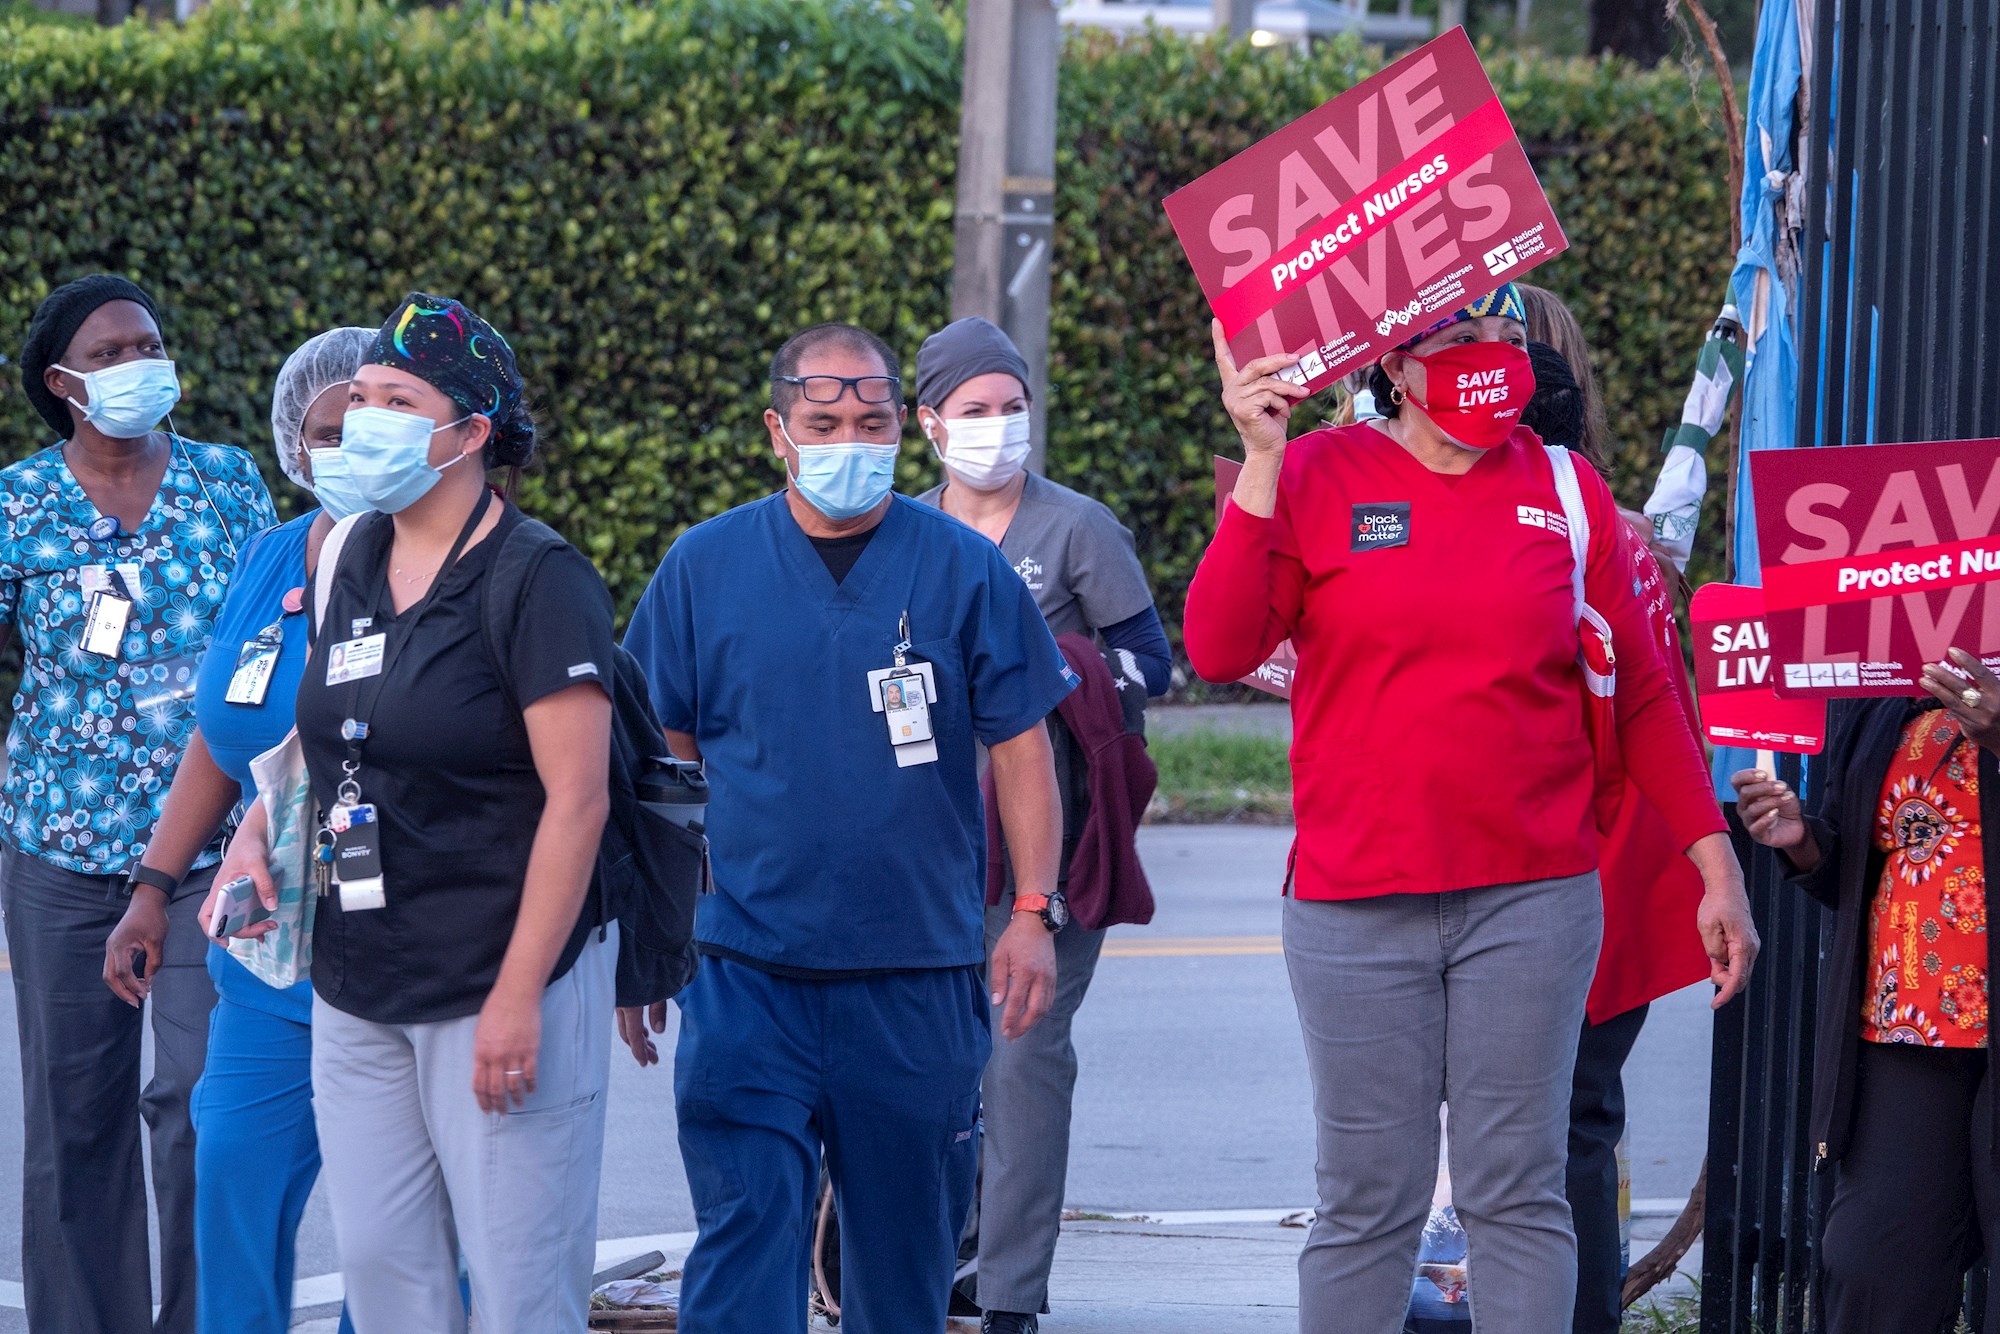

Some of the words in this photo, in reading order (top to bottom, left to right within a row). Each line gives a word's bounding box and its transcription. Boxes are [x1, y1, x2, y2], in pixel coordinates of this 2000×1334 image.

[1209, 52, 1455, 288] SAVE
[1271, 212, 1362, 291] Protect
[1362, 154, 1449, 225] Nurses
[1511, 222, 1545, 245] National
[1515, 234, 1543, 252] Nurses
[1519, 242, 1546, 260] United
[1256, 153, 1511, 360] LIVES
[1417, 276, 1449, 298] National
[1448, 263, 1474, 282] Nurses
[1421, 280, 1462, 305] Organizing
[1425, 287, 1466, 313] Committee
[1319, 331, 1357, 354] California
[1323, 344, 1350, 361] Nurses
[1328, 341, 1371, 369] Association
[1456, 368, 1506, 389] SAVE
[1458, 386, 1509, 407] LIVES
[1364, 514, 1398, 525] black
[1372, 523, 1404, 532] lives
[1358, 532, 1401, 542] matter
[1838, 555, 1952, 593] Protect
[1717, 655, 1774, 687] LIV
[1860, 661, 1903, 670] California
[1860, 670, 1892, 678] Nurses
[1862, 677, 1914, 686] Association
